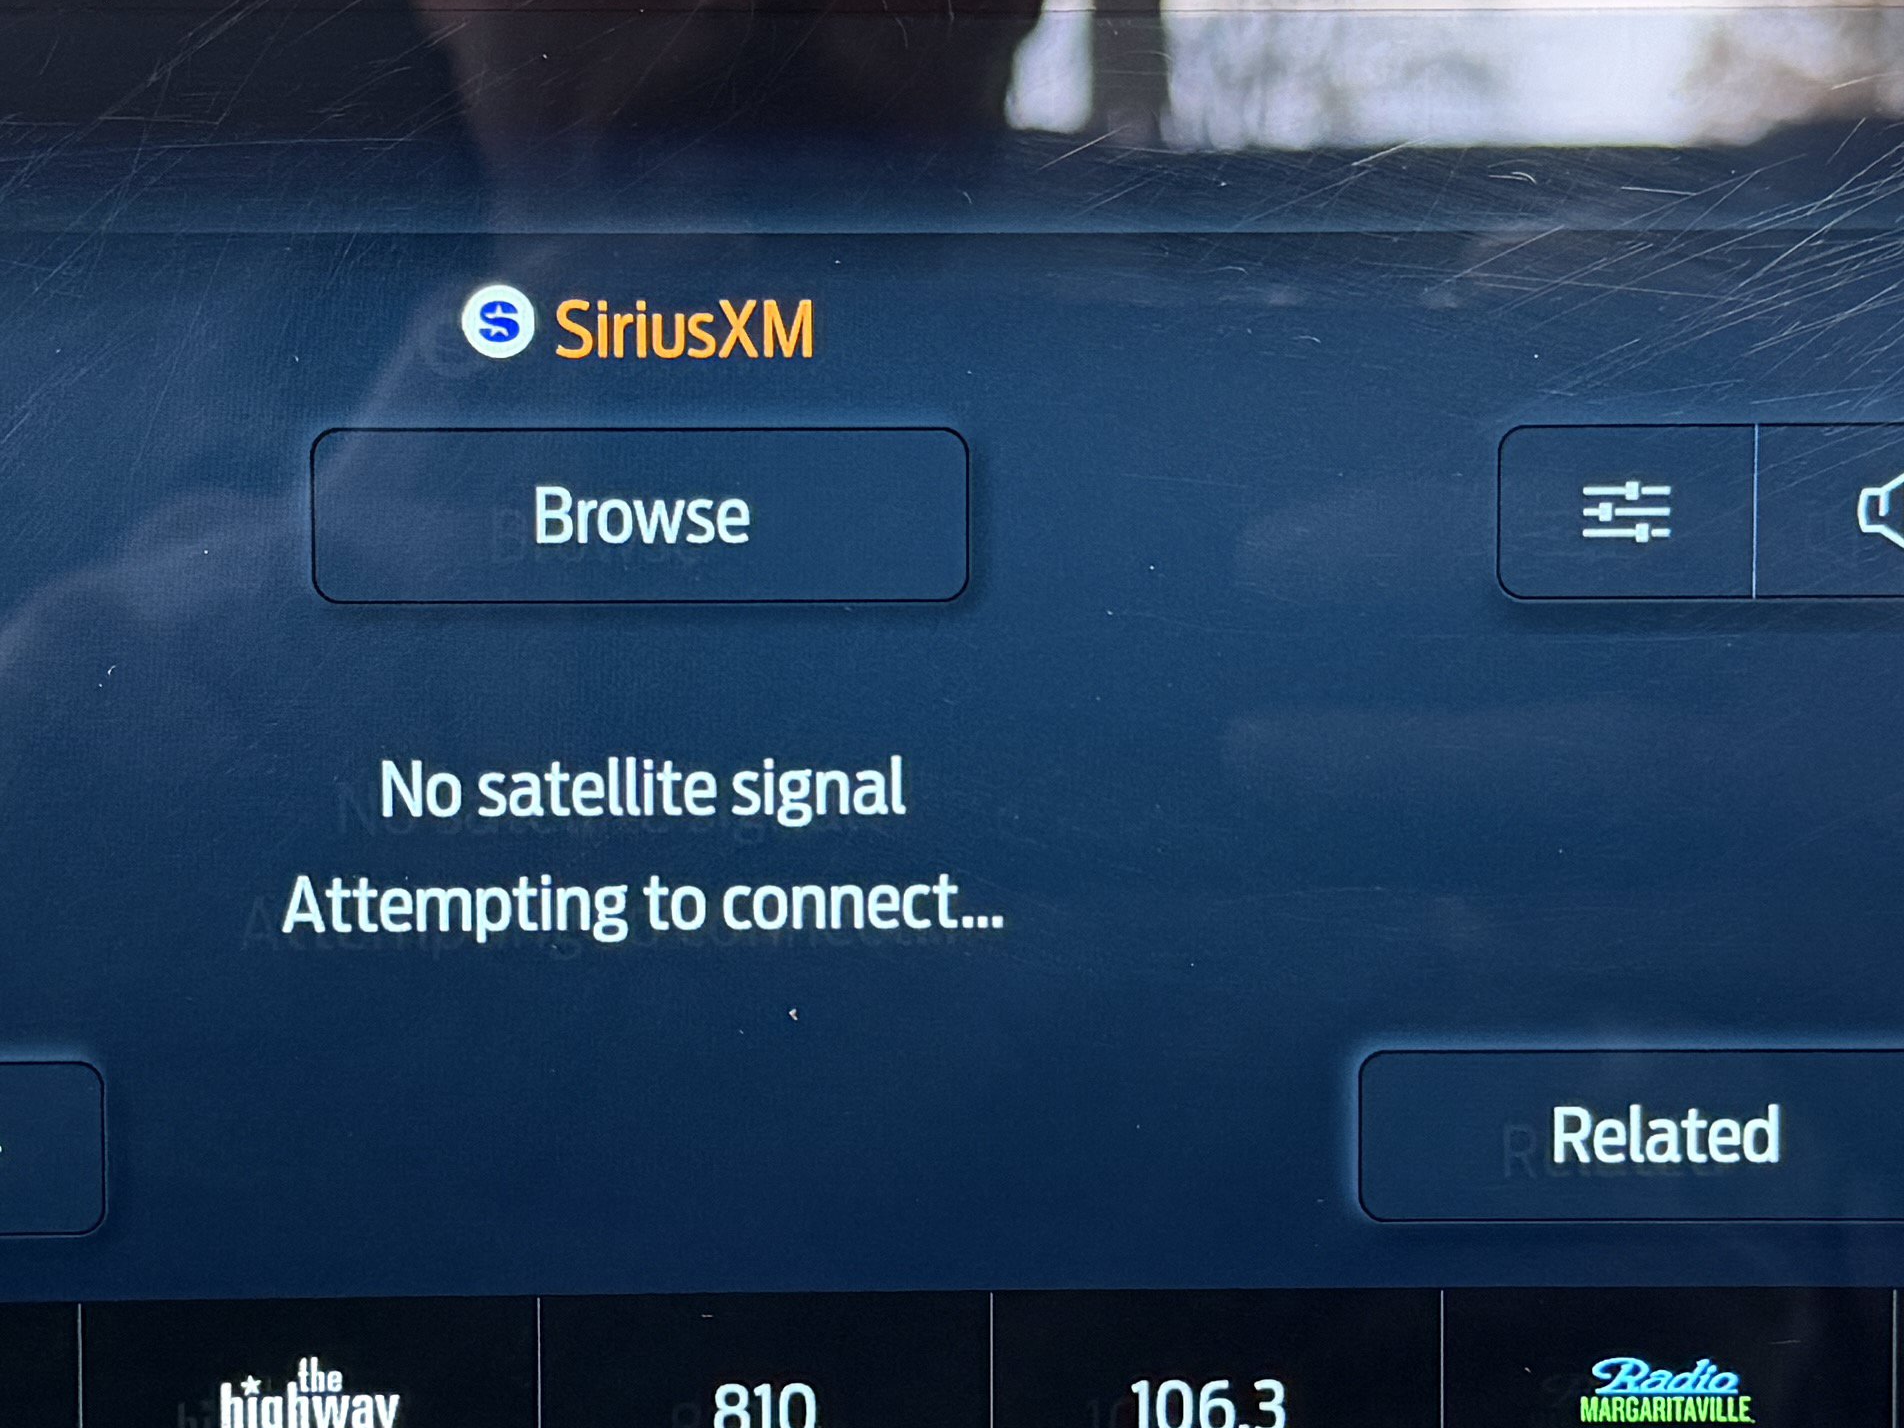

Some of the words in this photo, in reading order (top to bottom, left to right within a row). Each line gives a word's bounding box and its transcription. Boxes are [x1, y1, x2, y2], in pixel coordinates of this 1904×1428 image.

[556, 299, 812, 358] SiriusXM
[536, 486, 749, 543] Browse
[382, 760, 461, 817] No
[478, 757, 717, 817] satellite
[732, 755, 906, 827] signal
[282, 874, 628, 943] Attempting
[643, 875, 706, 930] to
[723, 874, 1003, 930] connect...
[1554, 1104, 1779, 1163] Related
[298, 1356, 344, 1393] the
[1591, 1357, 1741, 1394] Radio
